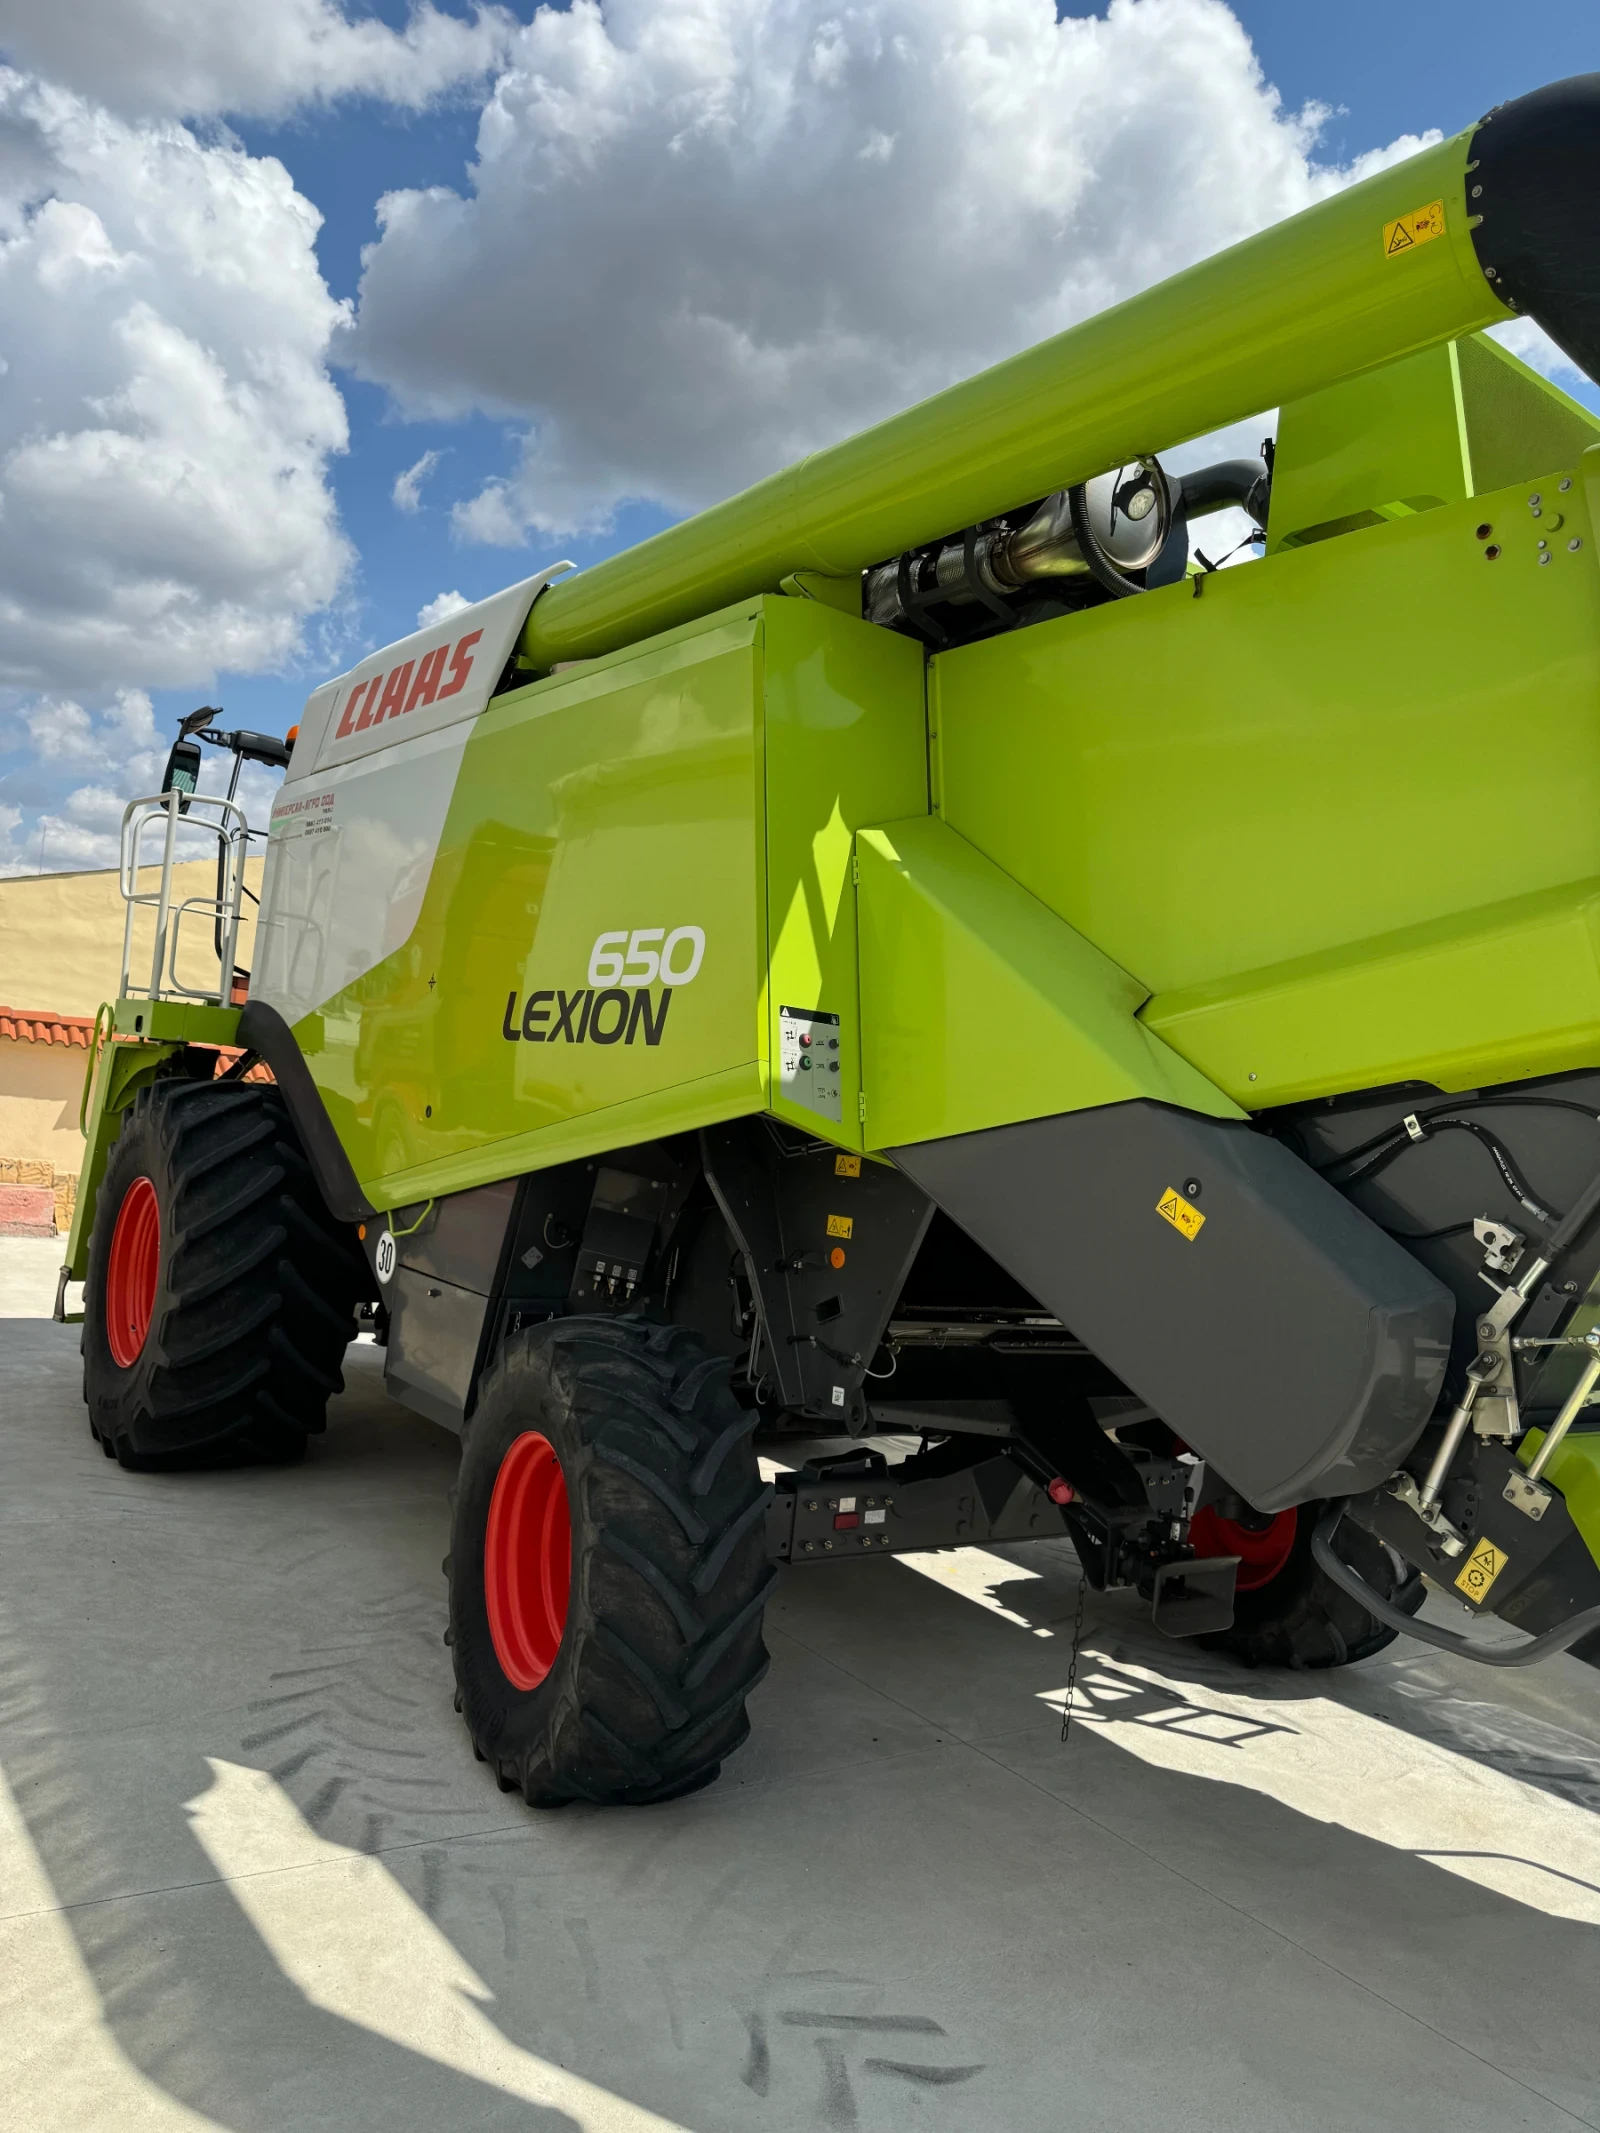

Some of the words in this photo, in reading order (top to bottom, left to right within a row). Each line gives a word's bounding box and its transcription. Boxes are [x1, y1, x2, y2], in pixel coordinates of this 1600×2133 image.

[335, 628, 484, 740] CLAAS
[587, 926, 706, 987] 650
[502, 988, 673, 1046] LEXION
[378, 1240, 393, 1274] 30
[1460, 1580, 1480, 1596] STOP
